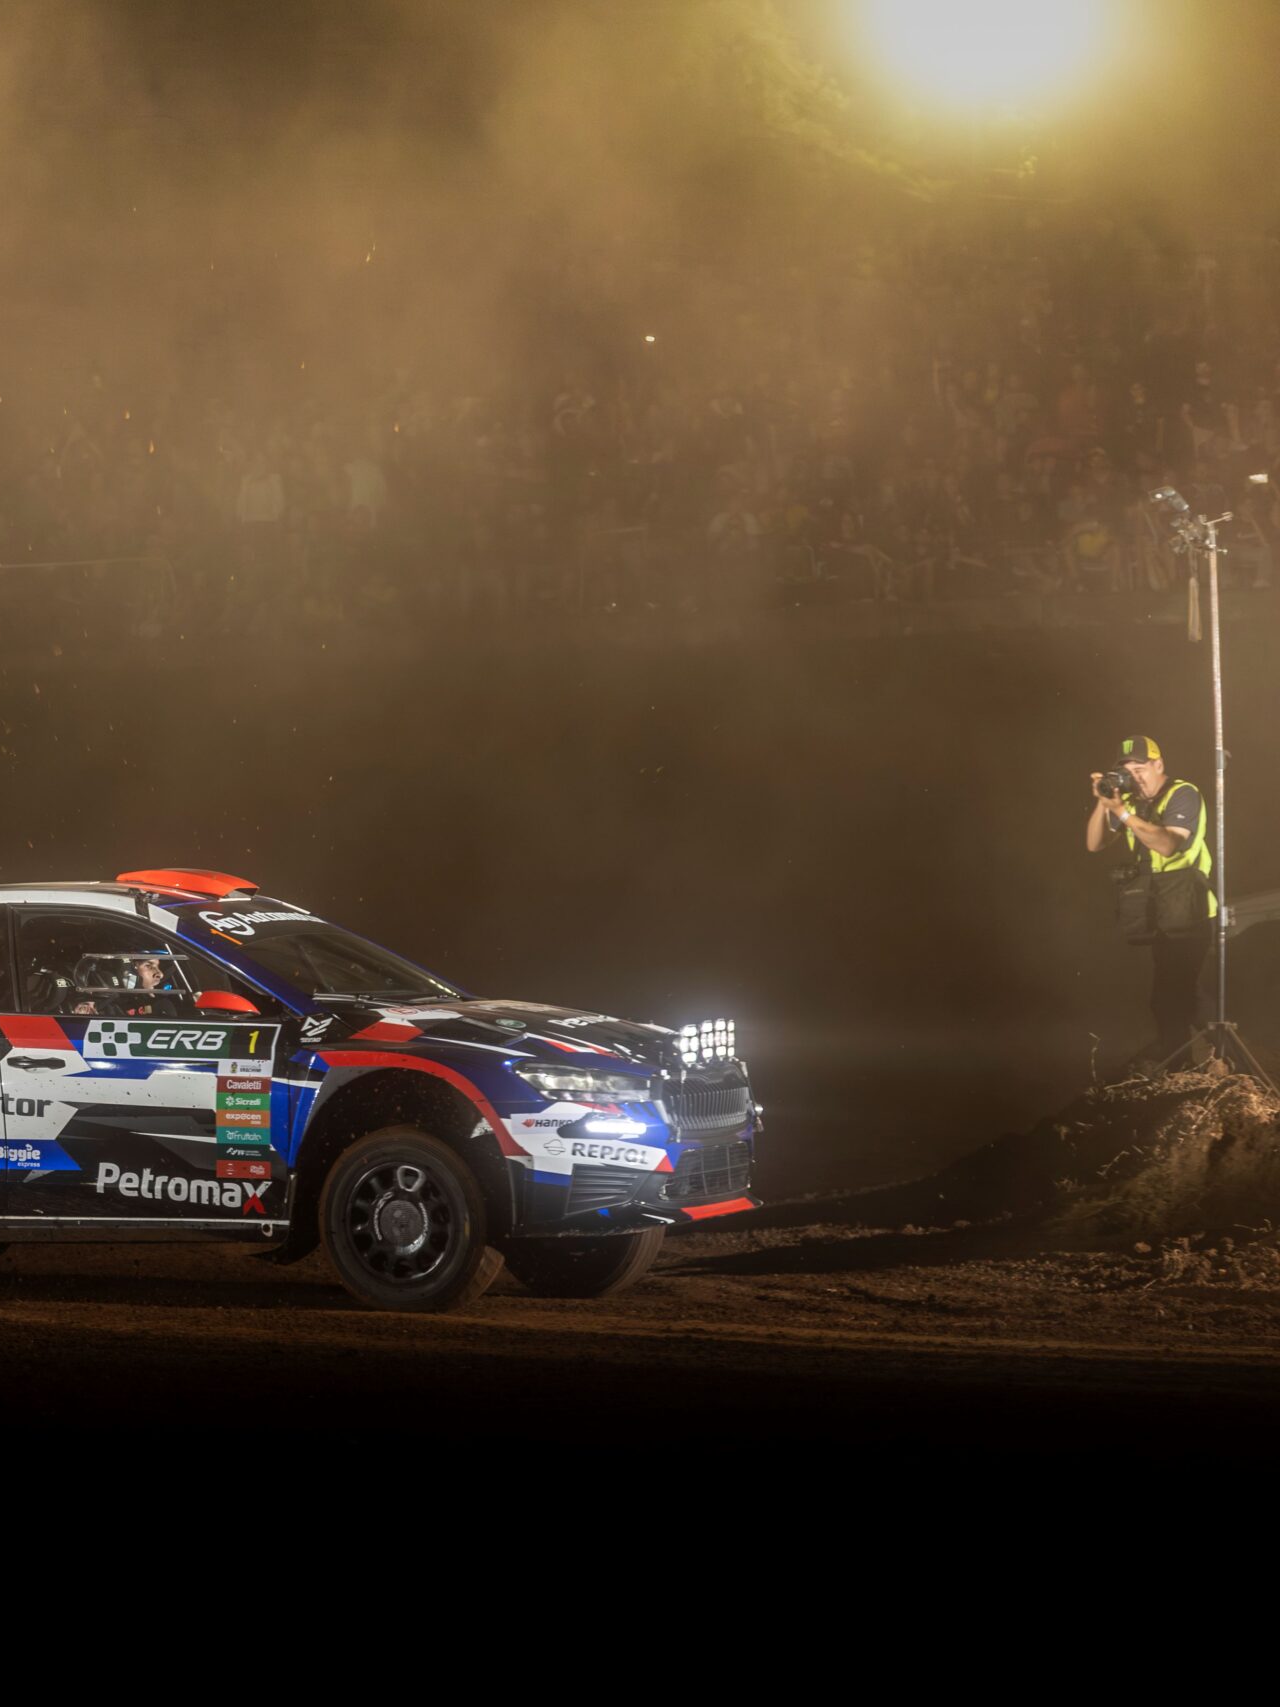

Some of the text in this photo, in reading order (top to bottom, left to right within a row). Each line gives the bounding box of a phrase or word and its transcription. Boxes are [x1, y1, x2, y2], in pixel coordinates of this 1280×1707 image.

[146, 1029, 228, 1050] ERB
[248, 1031, 260, 1054] 1
[571, 1142, 648, 1165] REPSOL
[96, 1162, 273, 1215] Petromax
